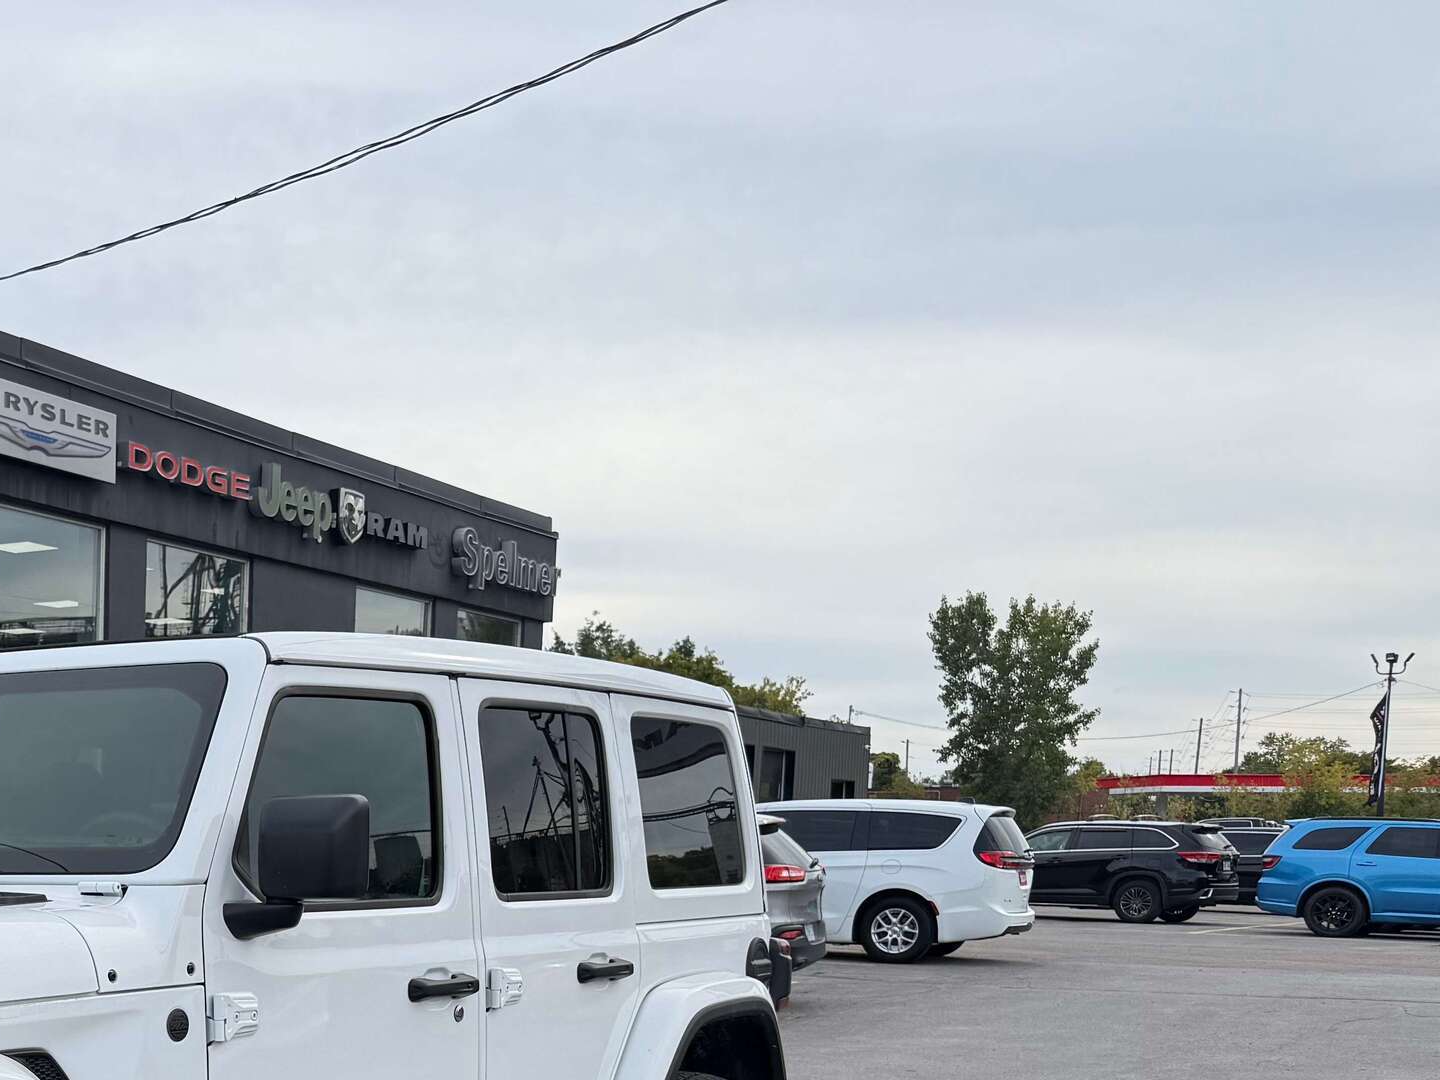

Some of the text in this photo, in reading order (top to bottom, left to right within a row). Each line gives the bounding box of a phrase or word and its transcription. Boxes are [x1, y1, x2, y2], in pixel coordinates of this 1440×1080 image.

[127, 439, 253, 501] DODGE
[255, 462, 333, 543] Jeep
[366, 511, 429, 549] RAM
[451, 526, 562, 597] Spelmer
